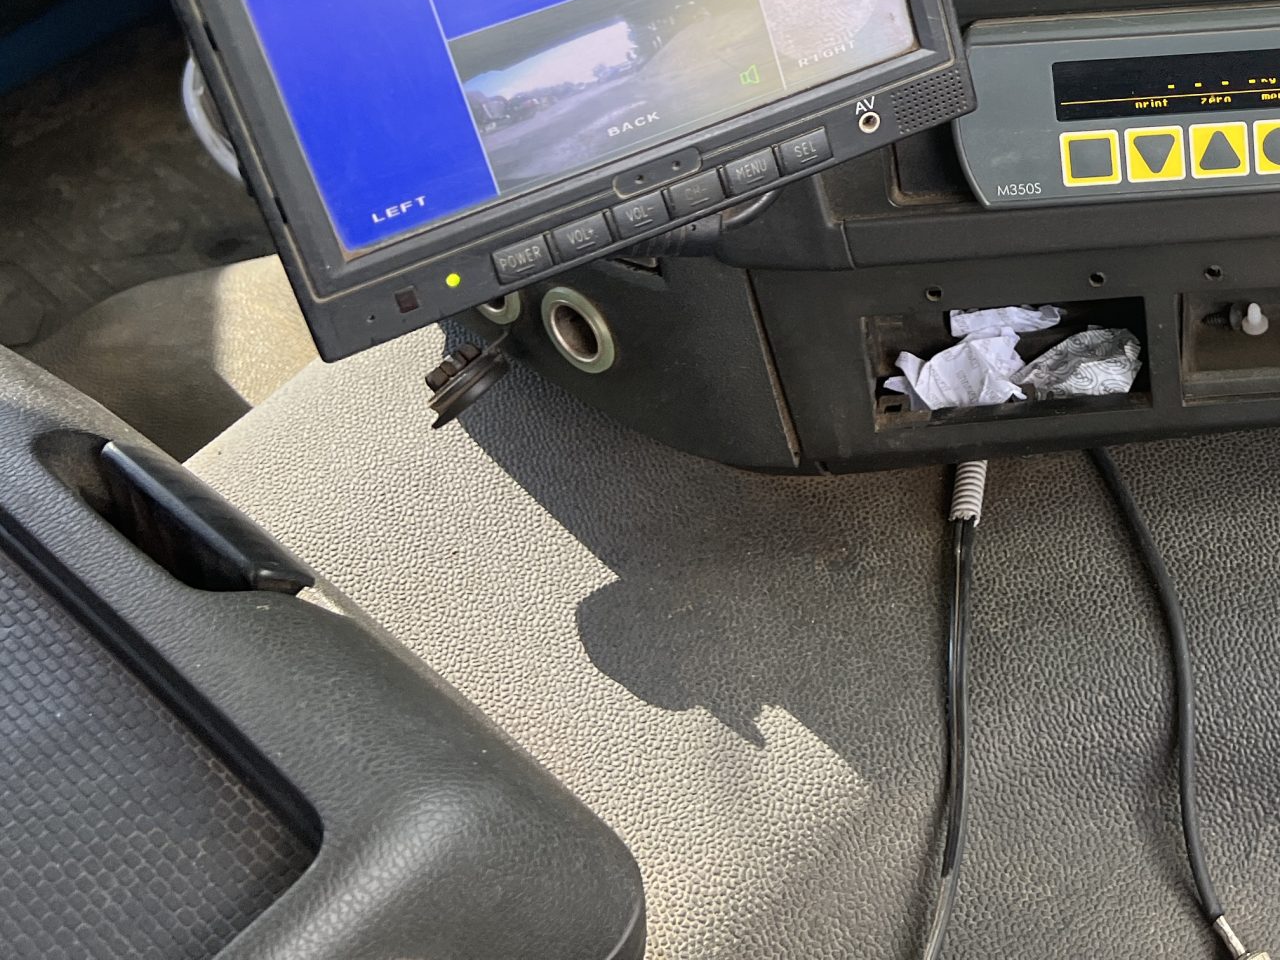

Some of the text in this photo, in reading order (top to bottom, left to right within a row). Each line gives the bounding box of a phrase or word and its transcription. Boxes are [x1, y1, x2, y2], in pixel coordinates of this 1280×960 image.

[798, 40, 855, 67] RIGHT
[856, 96, 875, 115] AV
[608, 111, 660, 136] BACK
[795, 142, 817, 158] SEL
[736, 160, 767, 181] MENU
[997, 183, 1042, 196] M350S
[371, 196, 426, 223] LEFT
[625, 206, 654, 222] VOL-
[567, 228, 594, 245] VOL+
[500, 246, 542, 271] POWER
